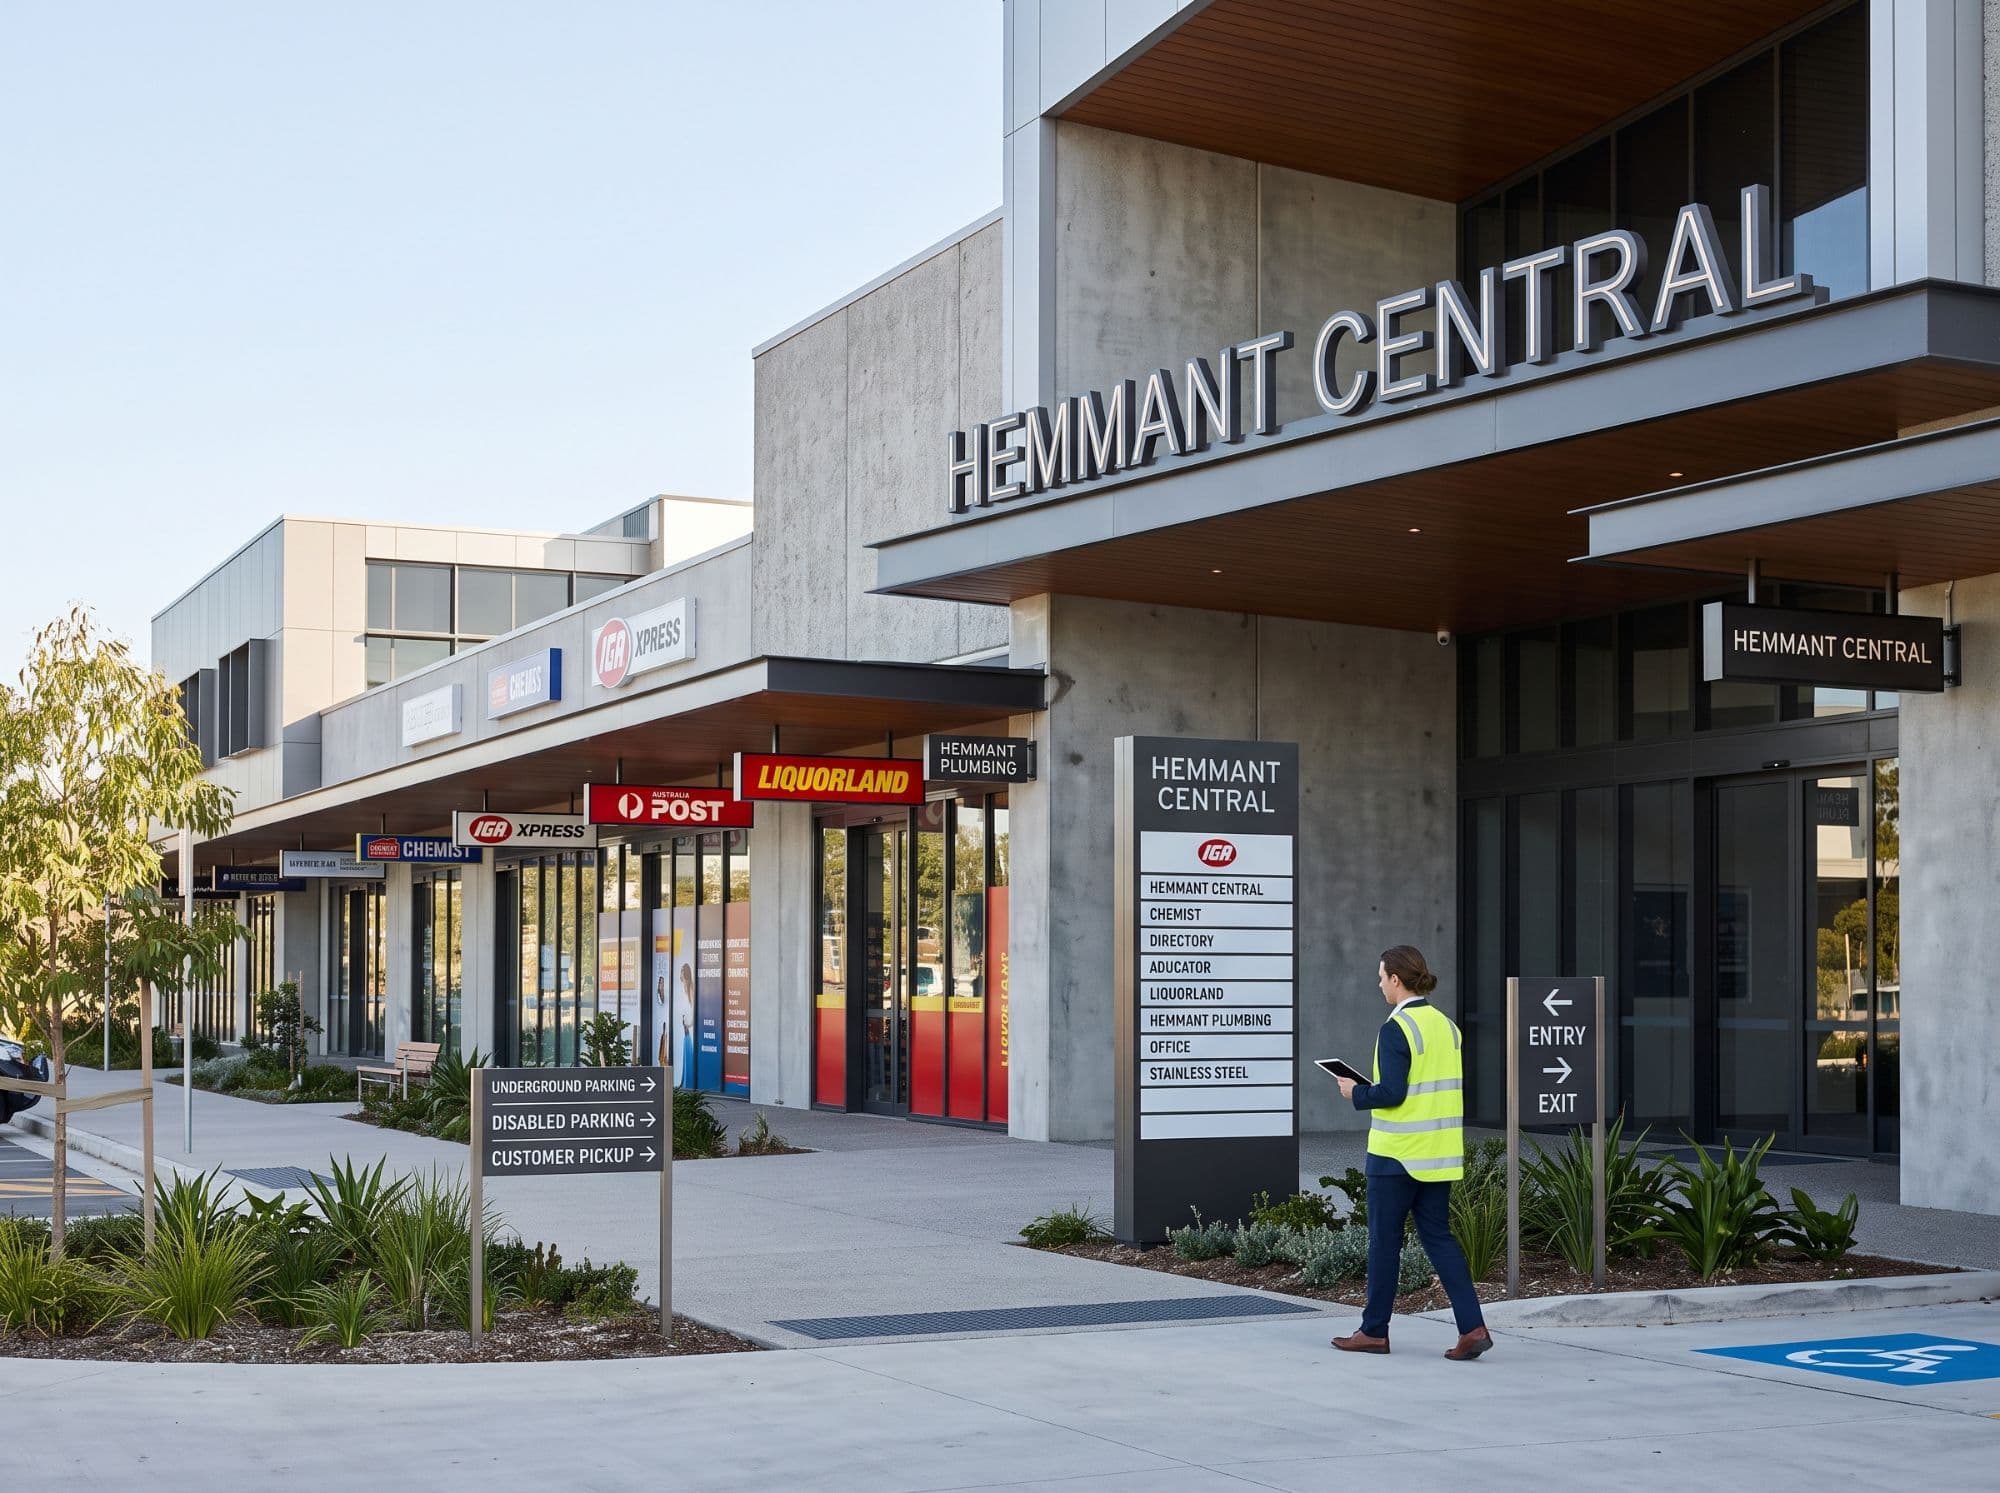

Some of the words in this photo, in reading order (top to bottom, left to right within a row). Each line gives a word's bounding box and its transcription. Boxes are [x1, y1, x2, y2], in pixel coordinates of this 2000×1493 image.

[947, 331, 1294, 512] HEMMANT
[1311, 184, 1814, 416] CENTRAL
[600, 629, 626, 674] IGA
[635, 616, 682, 658] XPRESS
[1733, 629, 1837, 657] HEMMANT
[1842, 637, 1932, 664] CENTRAL
[941, 741, 1017, 758] HEMMANT
[941, 758, 1017, 776] PLUMBING
[1151, 756, 1281, 784] HEMMANT
[757, 765, 909, 794] LIQUORLAND
[652, 791, 690, 799] AUSTRALIA
[1158, 786, 1275, 813] CENTRAL
[651, 799, 725, 822] POST
[474, 820, 507, 837] IGA
[516, 823, 585, 838] XPRESS
[1201, 844, 1234, 861] IGA
[1150, 881, 1209, 895] HEMMANT
[1212, 882, 1264, 896] CENTRAL
[1149, 907, 1201, 921] CHEMIST
[1150, 934, 1214, 947] DIRECTORY
[1149, 961, 1211, 974] ADUCATOR
[1150, 987, 1224, 1000] LIQUORLAND
[1150, 1014, 1209, 1027] HEMMANT
[1212, 1013, 1272, 1026] PLUMBING
[1529, 1026, 1586, 1046] ENTRY
[1150, 1040, 1191, 1054] OFFICE
[1150, 1067, 1212, 1080] STAINLESS
[1214, 1066, 1249, 1079] STEEL
[491, 1080, 582, 1094] UNDERGROUND
[585, 1079, 635, 1092] PARKING
[1538, 1093, 1578, 1113] EXIT
[492, 1114, 566, 1131] DISABLED
[570, 1112, 635, 1129] PARKING
[492, 1149, 574, 1167] CUSTOMER
[579, 1147, 634, 1164] PICKUP
